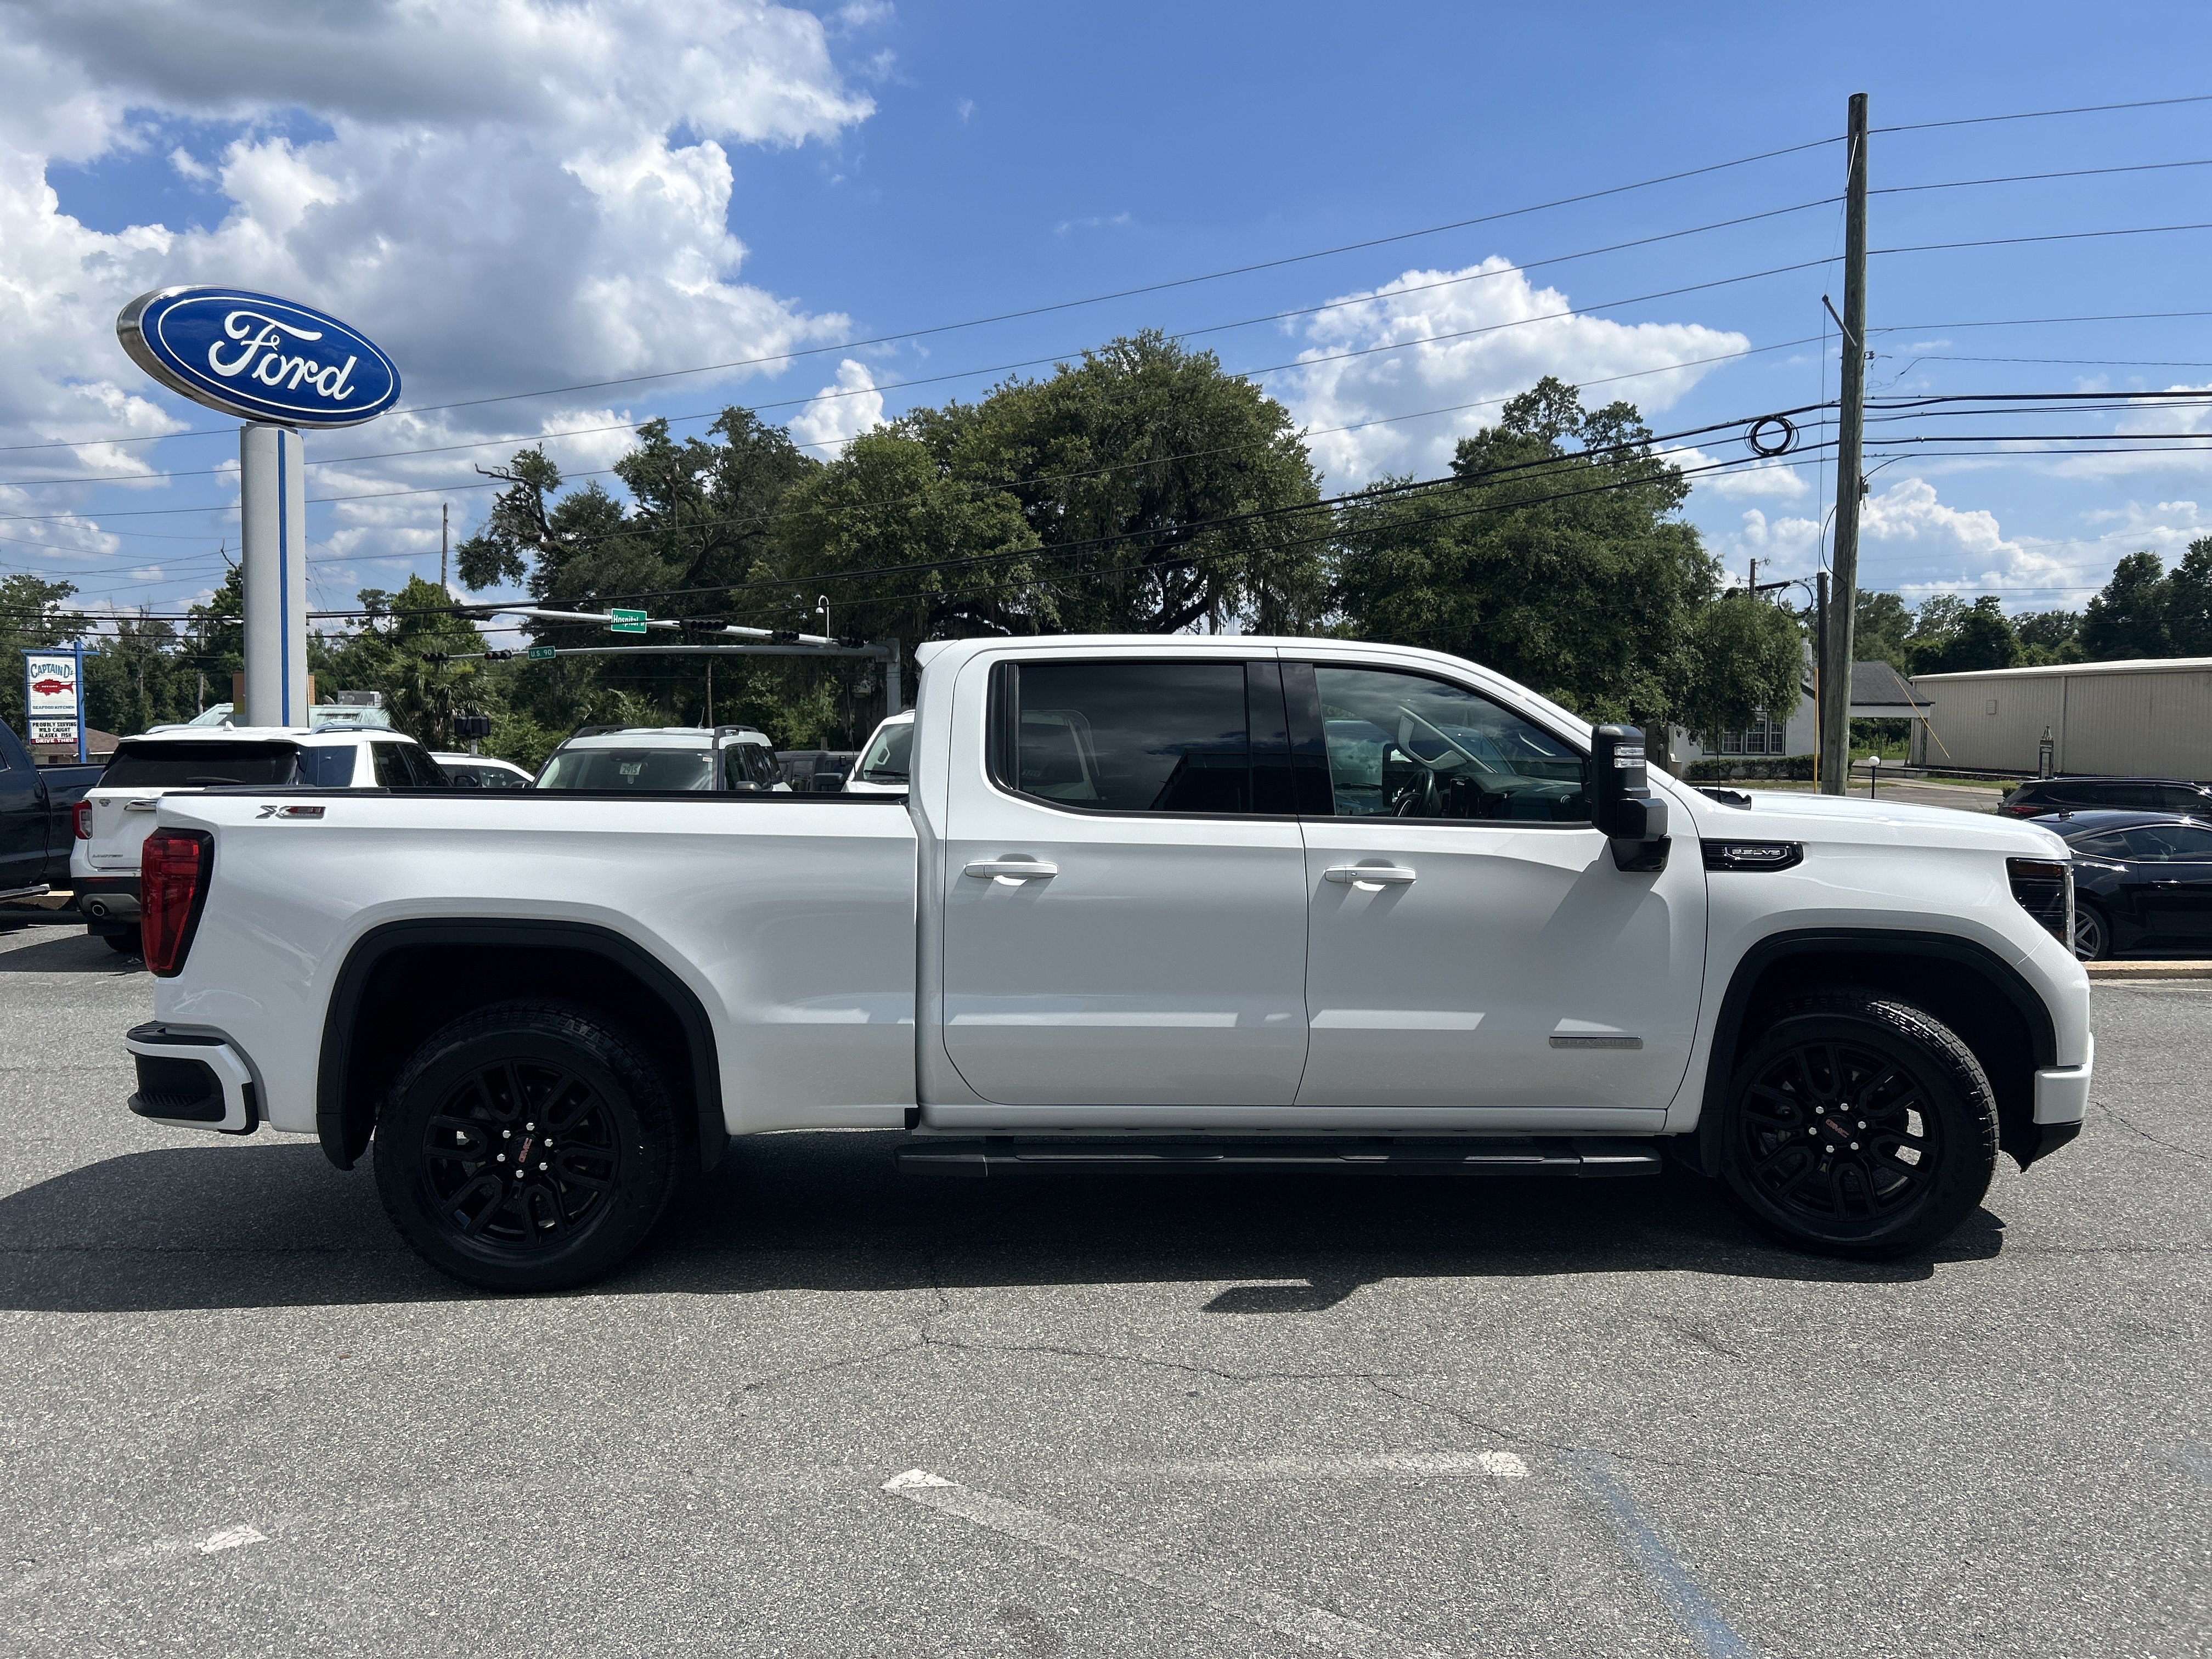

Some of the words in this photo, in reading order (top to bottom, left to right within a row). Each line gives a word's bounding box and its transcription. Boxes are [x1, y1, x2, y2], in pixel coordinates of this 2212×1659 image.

[208, 311, 354, 400] Ford
[613, 614, 639, 627] Hospital
[622, 766, 638, 774] 2915
[1825, 1119, 1850, 1138] GMC
[518, 1137, 533, 1163] GMC
